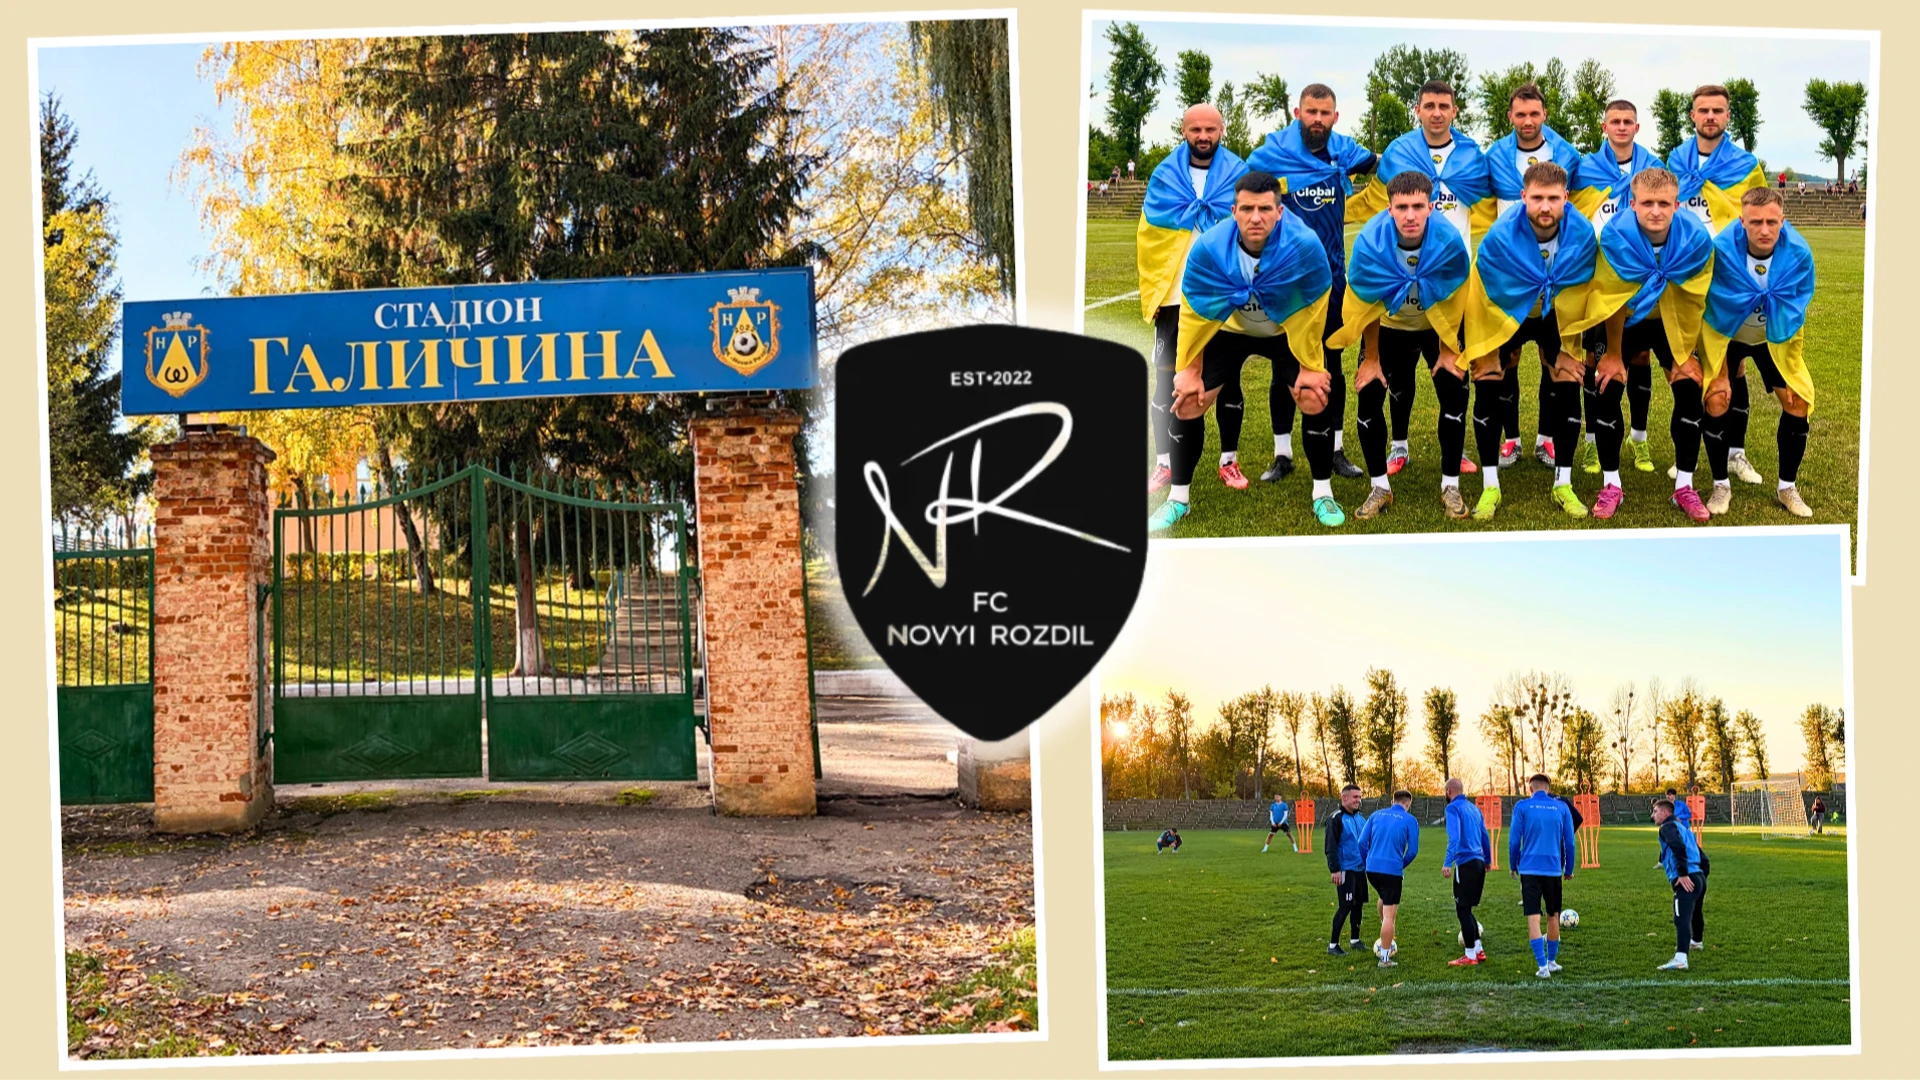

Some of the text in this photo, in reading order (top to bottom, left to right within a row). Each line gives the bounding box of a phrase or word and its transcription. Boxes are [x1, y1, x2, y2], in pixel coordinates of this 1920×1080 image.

[1296, 186, 1335, 197] Global
[1438, 191, 1457, 202] bal
[1688, 197, 1708, 207] Glo
[374, 297, 543, 333] СТАДІОН
[249, 329, 676, 395] ГАЛИЧИНА
